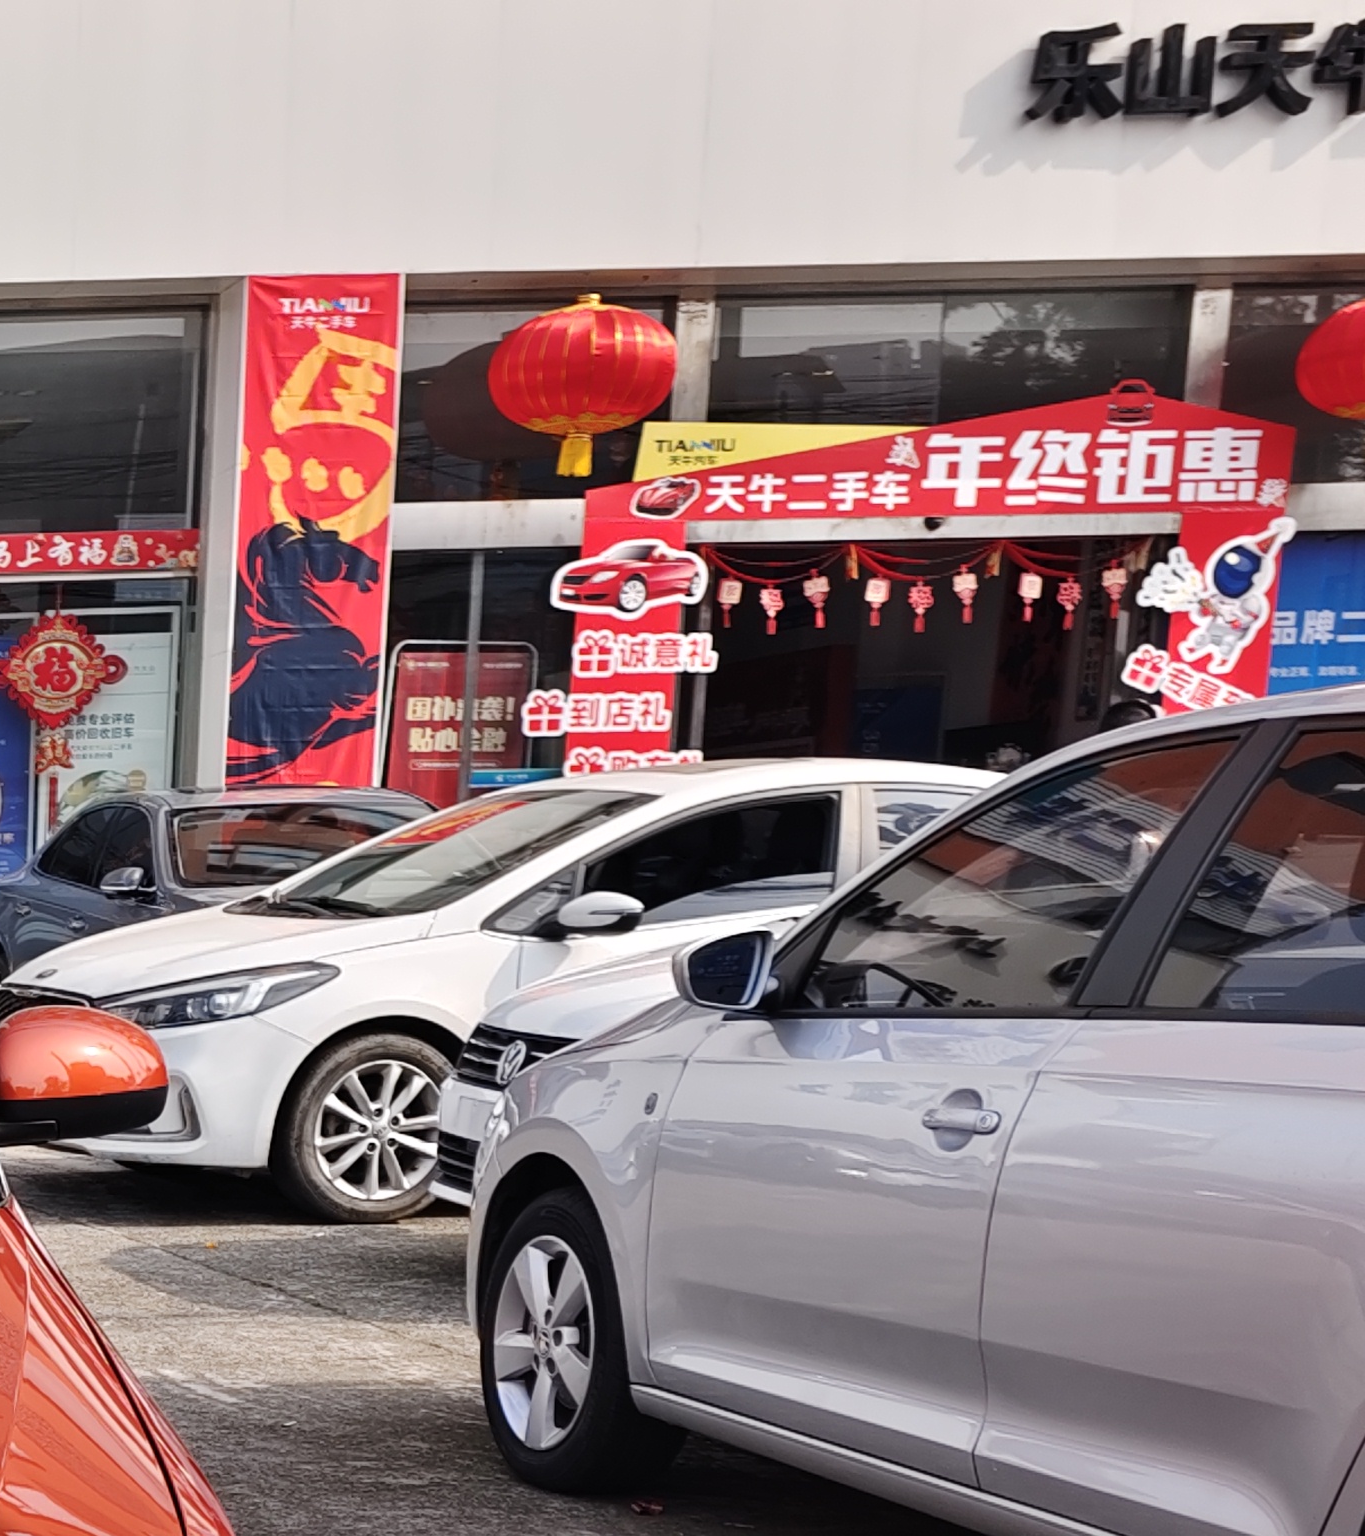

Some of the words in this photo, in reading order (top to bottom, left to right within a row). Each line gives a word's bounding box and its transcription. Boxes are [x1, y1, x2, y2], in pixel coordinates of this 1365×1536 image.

[704, 471, 912, 514] 天牛二手车
[921, 427, 1264, 508] 年终钜惠
[619, 637, 713, 669] 诚意礼
[1167, 663, 1243, 708] 专属
[569, 697, 666, 728] 到店礼
